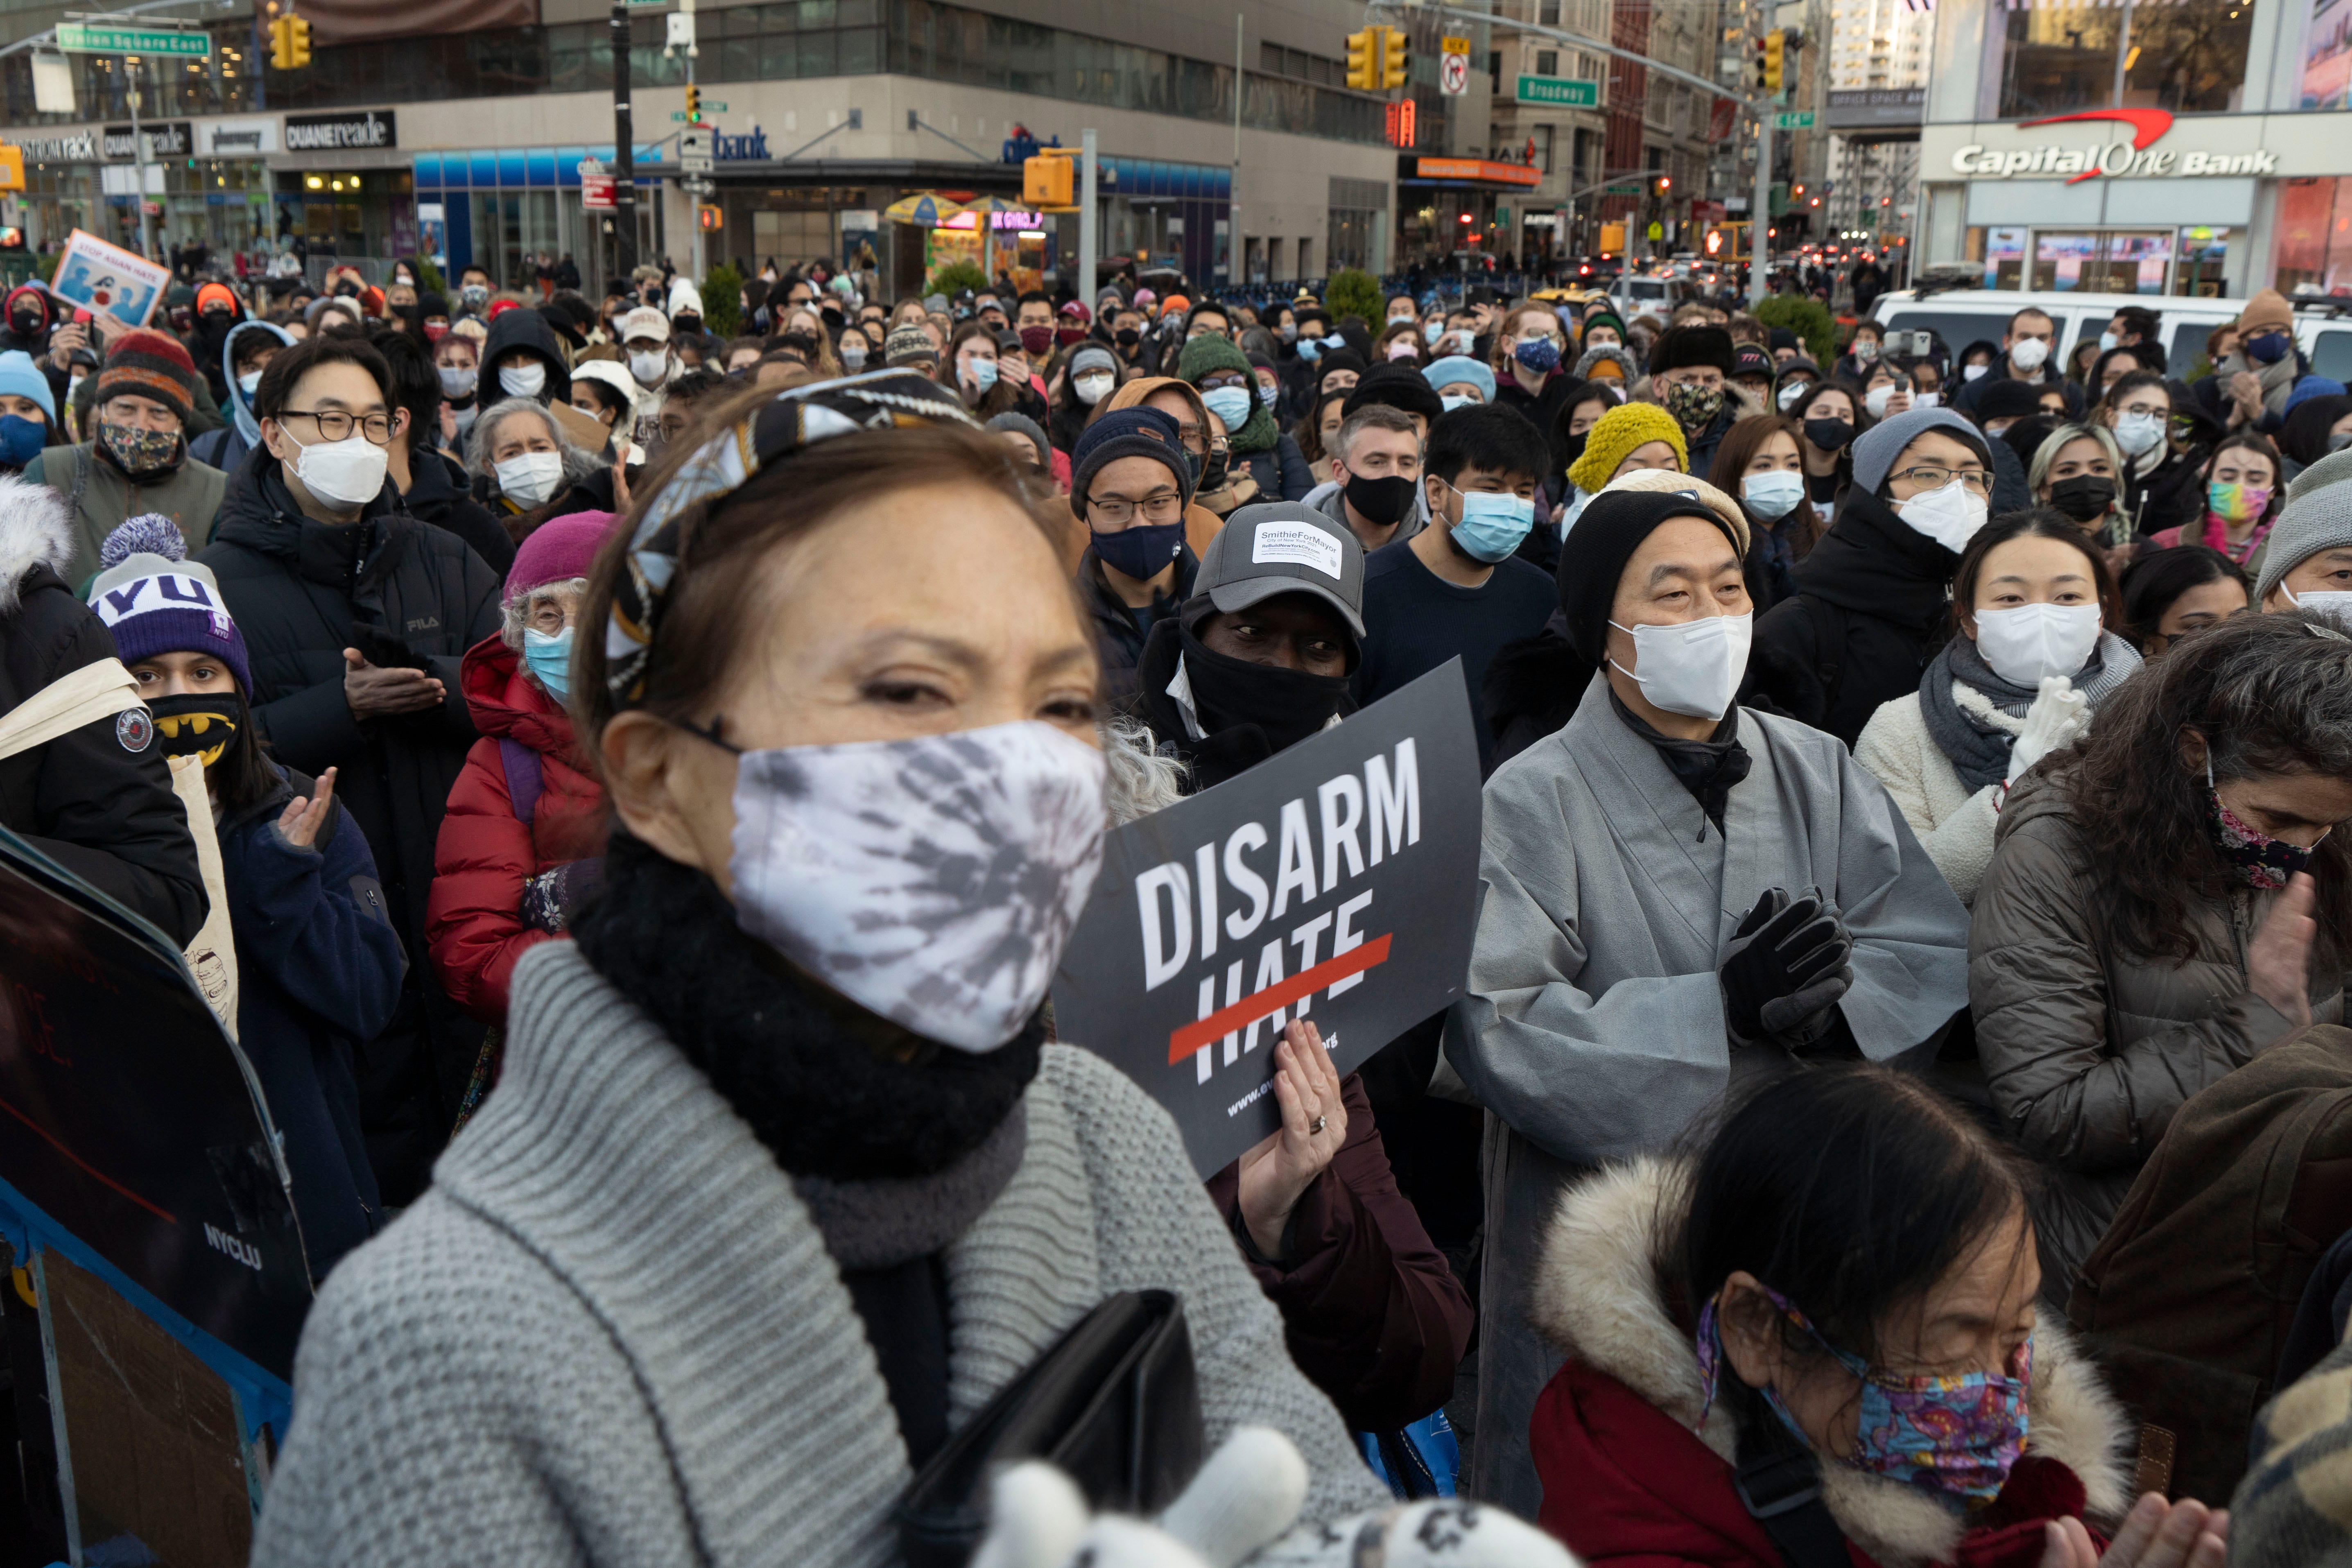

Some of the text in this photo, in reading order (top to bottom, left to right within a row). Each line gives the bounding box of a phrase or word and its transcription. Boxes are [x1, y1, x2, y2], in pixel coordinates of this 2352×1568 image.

[64, 32, 204, 51] Union Square East
[1448, 40, 1464, 50] NEW
[1527, 80, 1585, 105] Broadway
[1786, 113, 1800, 127] 14
[63, 129, 95, 160] rack
[712, 124, 766, 160] bank
[2181, 150, 2277, 174] Bank
[79, 243, 157, 283] STOP ASIAN HATE
[1262, 531, 1337, 553] SmithieForMayor
[1262, 544, 1320, 555] ReBuildNewYorkCity.com
[213, 627, 229, 639] NYU
[407, 616, 440, 632] FILA
[1135, 737, 1420, 992] DISARM
[1196, 888, 1373, 1085] HATE
[204, 1222, 262, 1270] NYCLU
